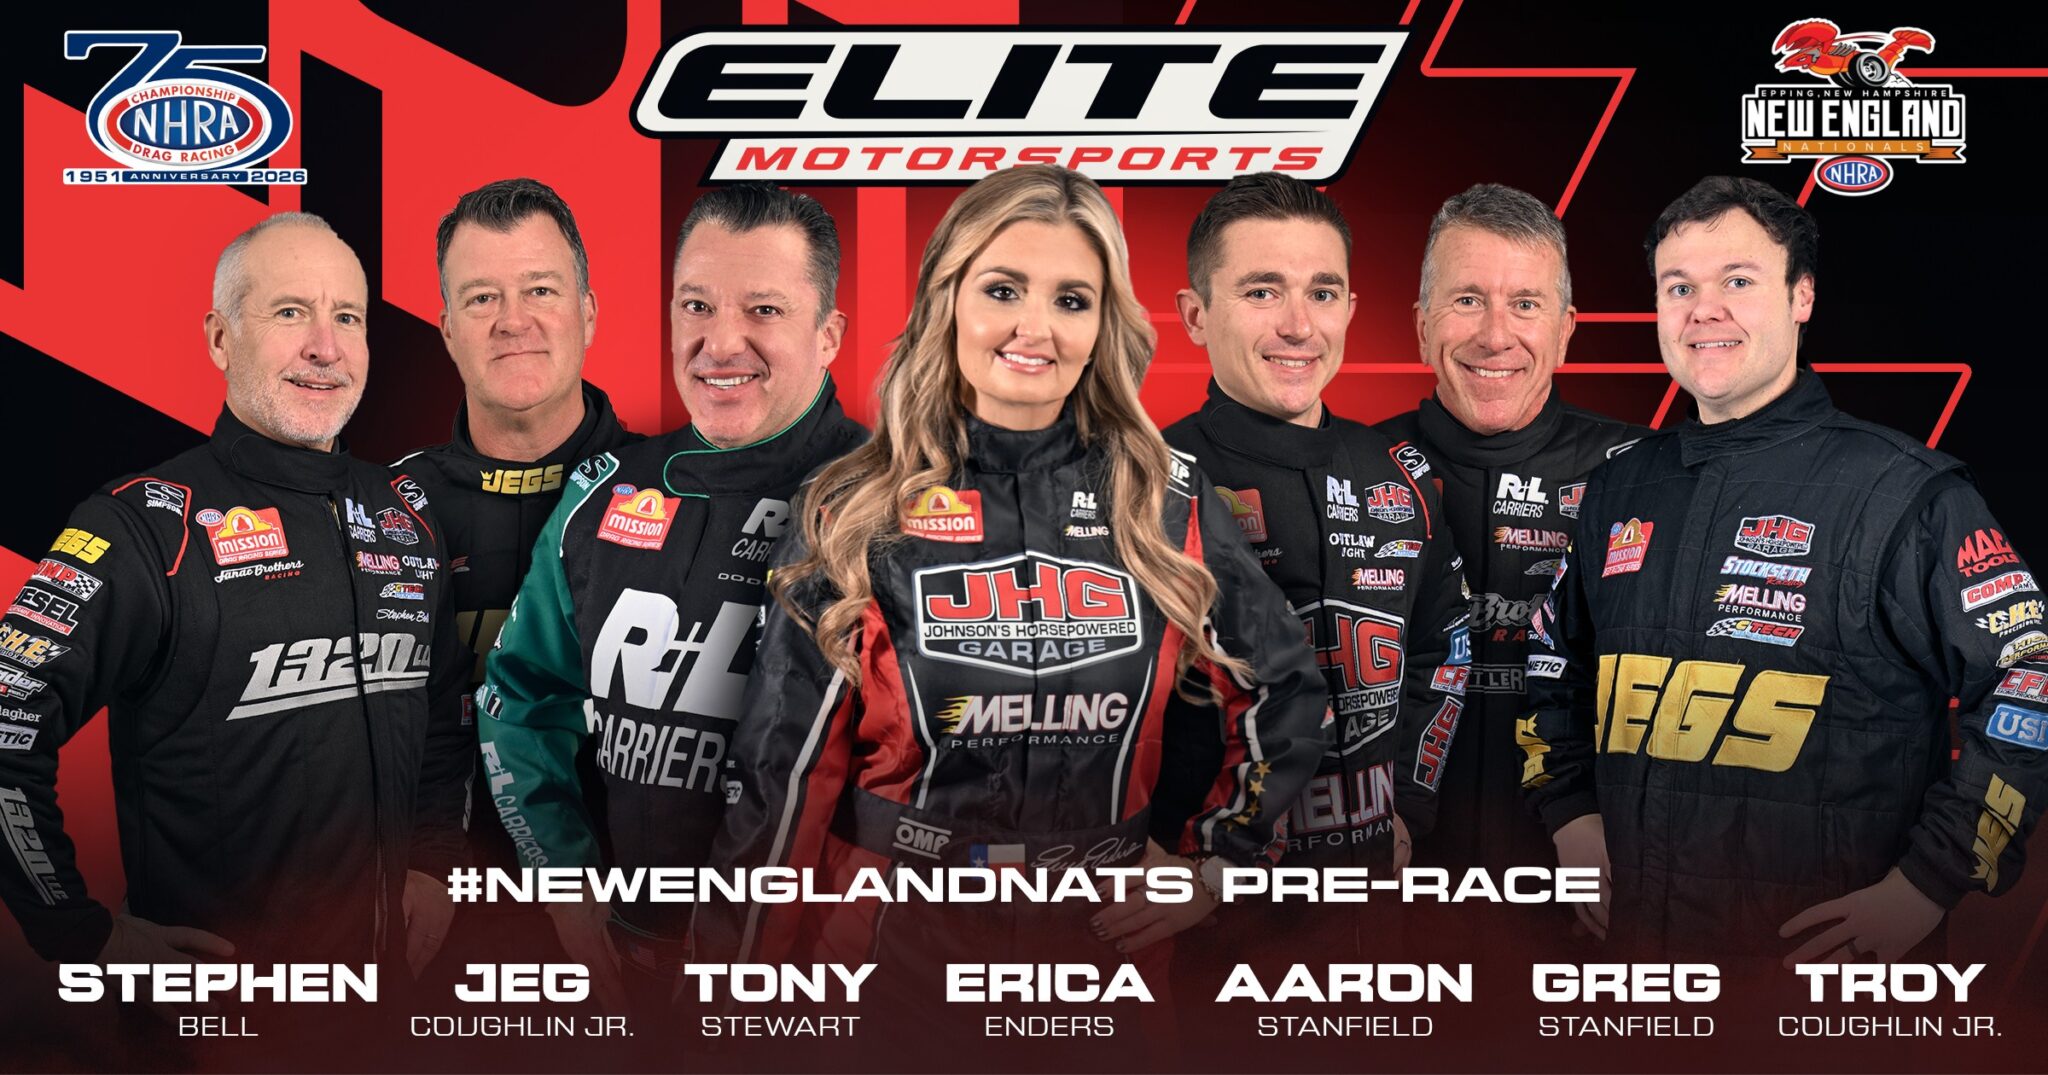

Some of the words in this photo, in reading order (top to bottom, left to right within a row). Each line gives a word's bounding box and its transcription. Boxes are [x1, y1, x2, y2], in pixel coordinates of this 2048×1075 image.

[480, 464, 564, 495] JEGS
[1367, 485, 1413, 508] JHG
[1493, 500, 1544, 518] CARRIERS
[1066, 524, 1110, 538] MELLING
[1501, 527, 1569, 548] MELLING
[1742, 518, 1810, 542] JHG
[1500, 543, 1567, 554] PERFORMANCE
[1747, 543, 1796, 554] GARAGE
[254, 560, 304, 577] Brothers
[1358, 567, 1405, 586] MELLING
[1720, 556, 1812, 584] STOCKSETH
[927, 561, 1129, 620] JHG
[1720, 584, 1807, 613] MELLING
[1966, 574, 2024, 604] COMP
[1718, 604, 1802, 623] PERFORMANCE
[924, 624, 1011, 638] JOHNSON'S
[1016, 621, 1137, 637] HORSEPOWERED
[1751, 621, 1801, 639] TECH
[958, 639, 1107, 663] GARAGE
[239, 632, 416, 703] 1320
[954, 692, 1129, 734] MELLING
[595, 710, 727, 793] CARRIER
[951, 733, 1119, 749] PERFORMANCE
[1420, 700, 1464, 786] JHG
[896, 822, 950, 855] OMP
